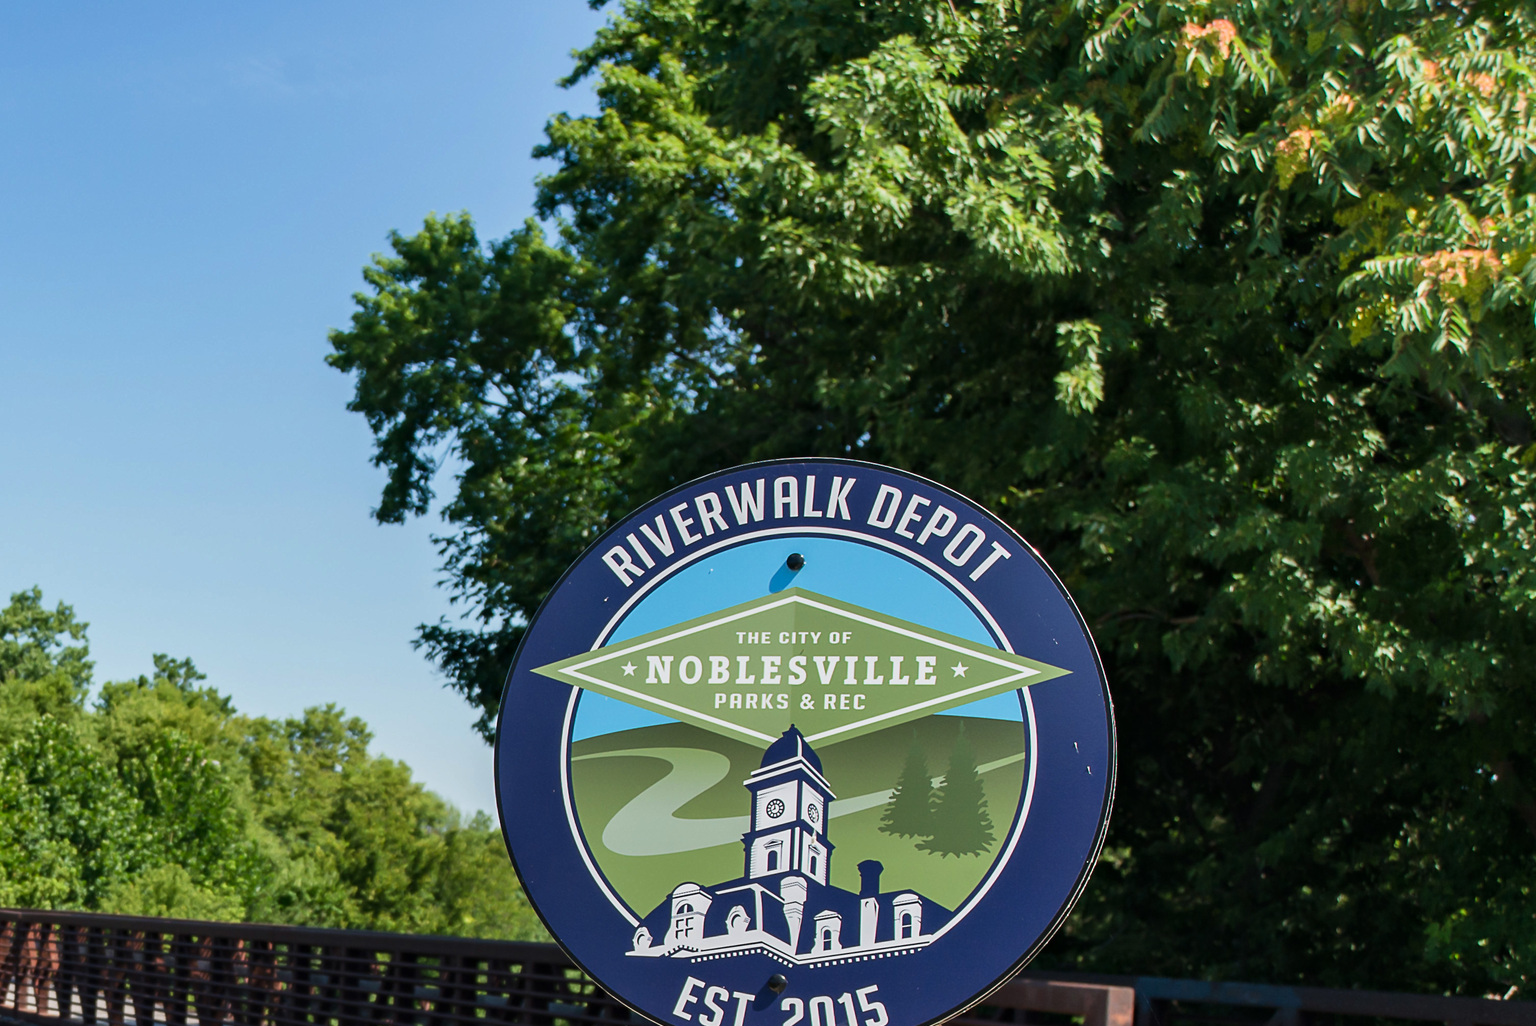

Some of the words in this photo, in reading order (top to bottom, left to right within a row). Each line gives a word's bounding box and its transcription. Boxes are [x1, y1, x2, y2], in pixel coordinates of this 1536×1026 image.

[602, 475, 857, 587] RIVERWALK
[867, 484, 1012, 582] DEPOT
[736, 631, 771, 645] THE
[779, 631, 822, 645] CITY
[829, 631, 853, 645] OF
[645, 655, 938, 686] NOBLESVILLE
[714, 693, 789, 710] PARKS
[800, 694, 816, 710] &
[824, 694, 866, 710] REC
